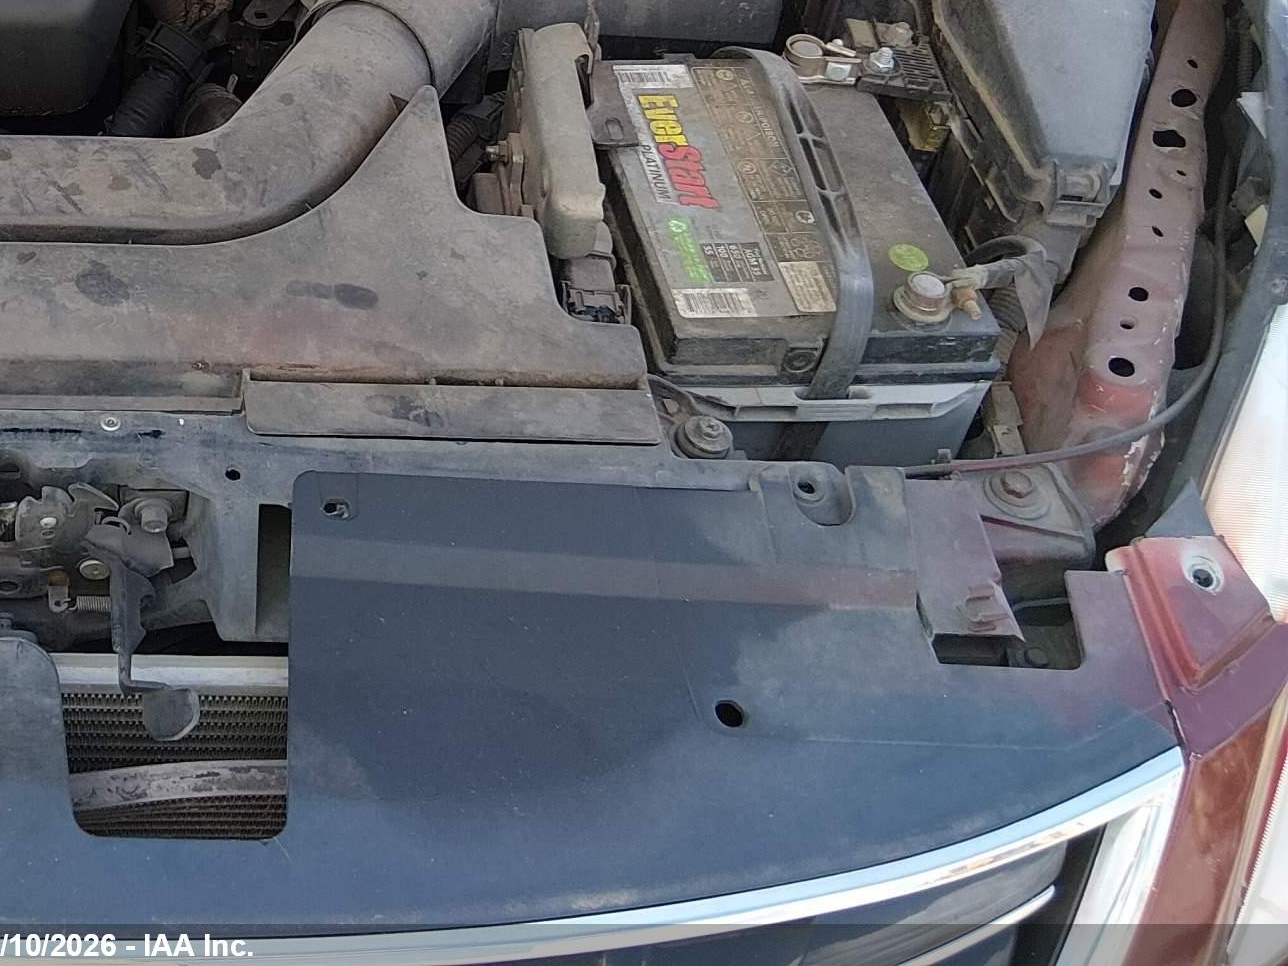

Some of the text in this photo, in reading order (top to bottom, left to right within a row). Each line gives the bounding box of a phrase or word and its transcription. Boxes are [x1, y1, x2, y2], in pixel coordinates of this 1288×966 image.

[637, 94, 720, 209] EverStart
[640, 144, 673, 201] PLATINUM
[715, 245, 729, 257] 100
[743, 248, 758, 265] AGM
